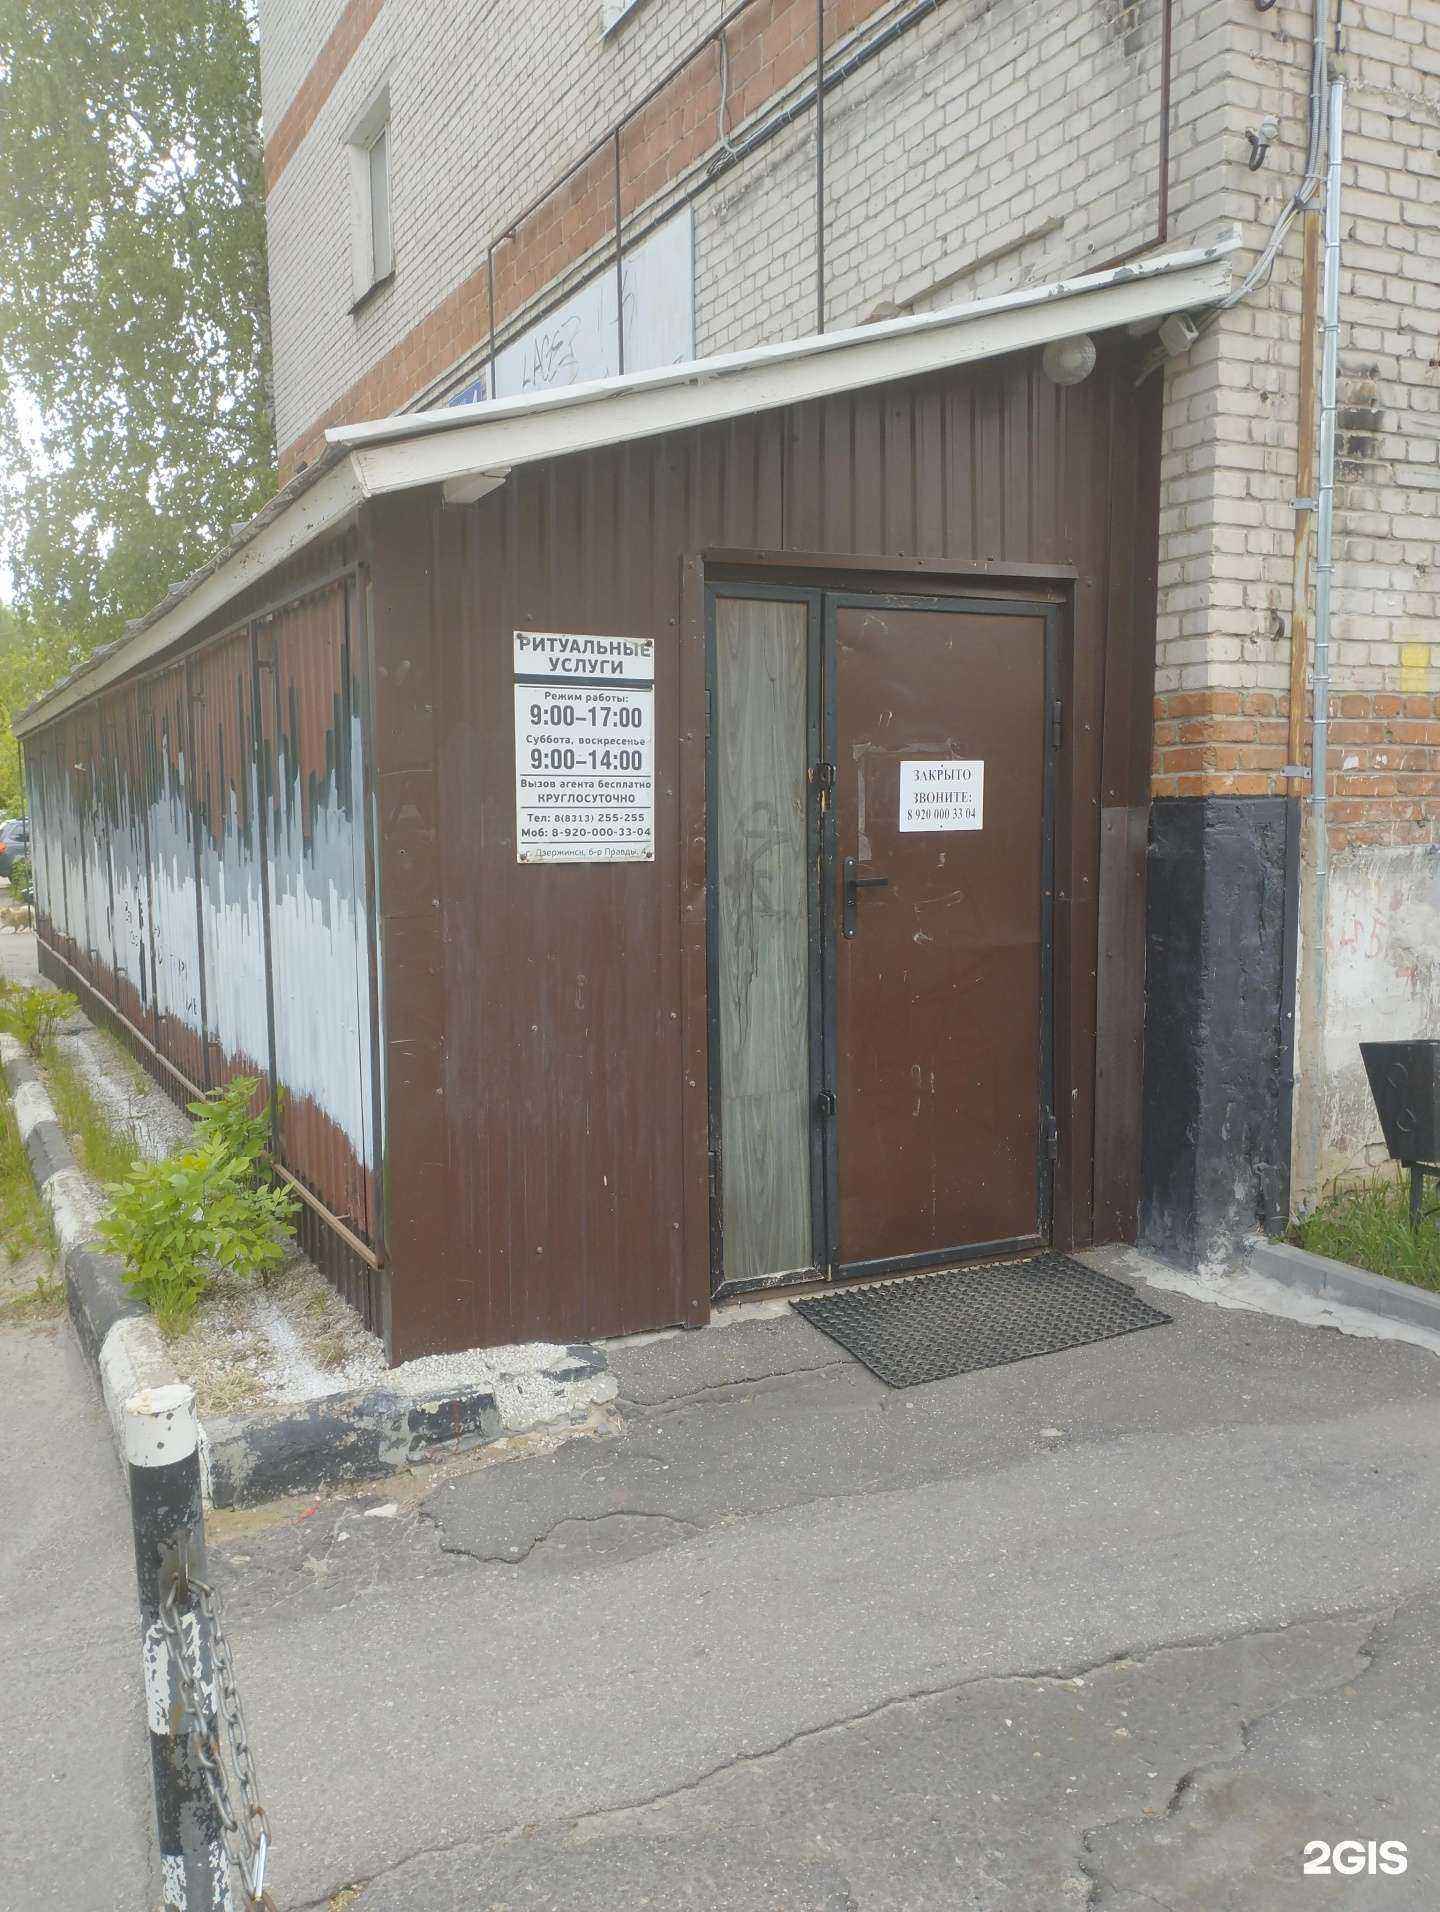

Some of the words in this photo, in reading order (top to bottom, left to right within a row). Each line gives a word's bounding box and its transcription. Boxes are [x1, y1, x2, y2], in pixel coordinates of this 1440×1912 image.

[519, 637, 651, 657] РИТУАЛЬНЫЕ
[549, 657, 623, 674] УСЛУГИ
[544, 691, 582, 701] Режим
[585, 694, 629, 703] работы:
[526, 735, 574, 745] Суббота,
[579, 737, 646, 746] воскресенье
[913, 768, 971, 781] ЗАКРЫТО
[520, 779, 556, 788] Вызов
[559, 781, 595, 789] агента
[598, 780, 651, 789] бесплатно
[538, 794, 636, 803] КРУГЛОСУТОЧНО
[914, 791, 972, 803] ЗВОНИТЕ:
[527, 814, 551, 823] Тел:
[554, 814, 594, 823] 8(8313)
[598, 813, 645, 822] 255-255
[907, 809, 913, 820] 8
[915, 809, 931, 820] 920
[933, 808, 950, 820] 000
[952, 808, 962, 819] 33
[965, 807, 976, 819] 04
[521, 828, 548, 837] Моб:
[552, 828, 651, 837] 8-920-000-33-04
